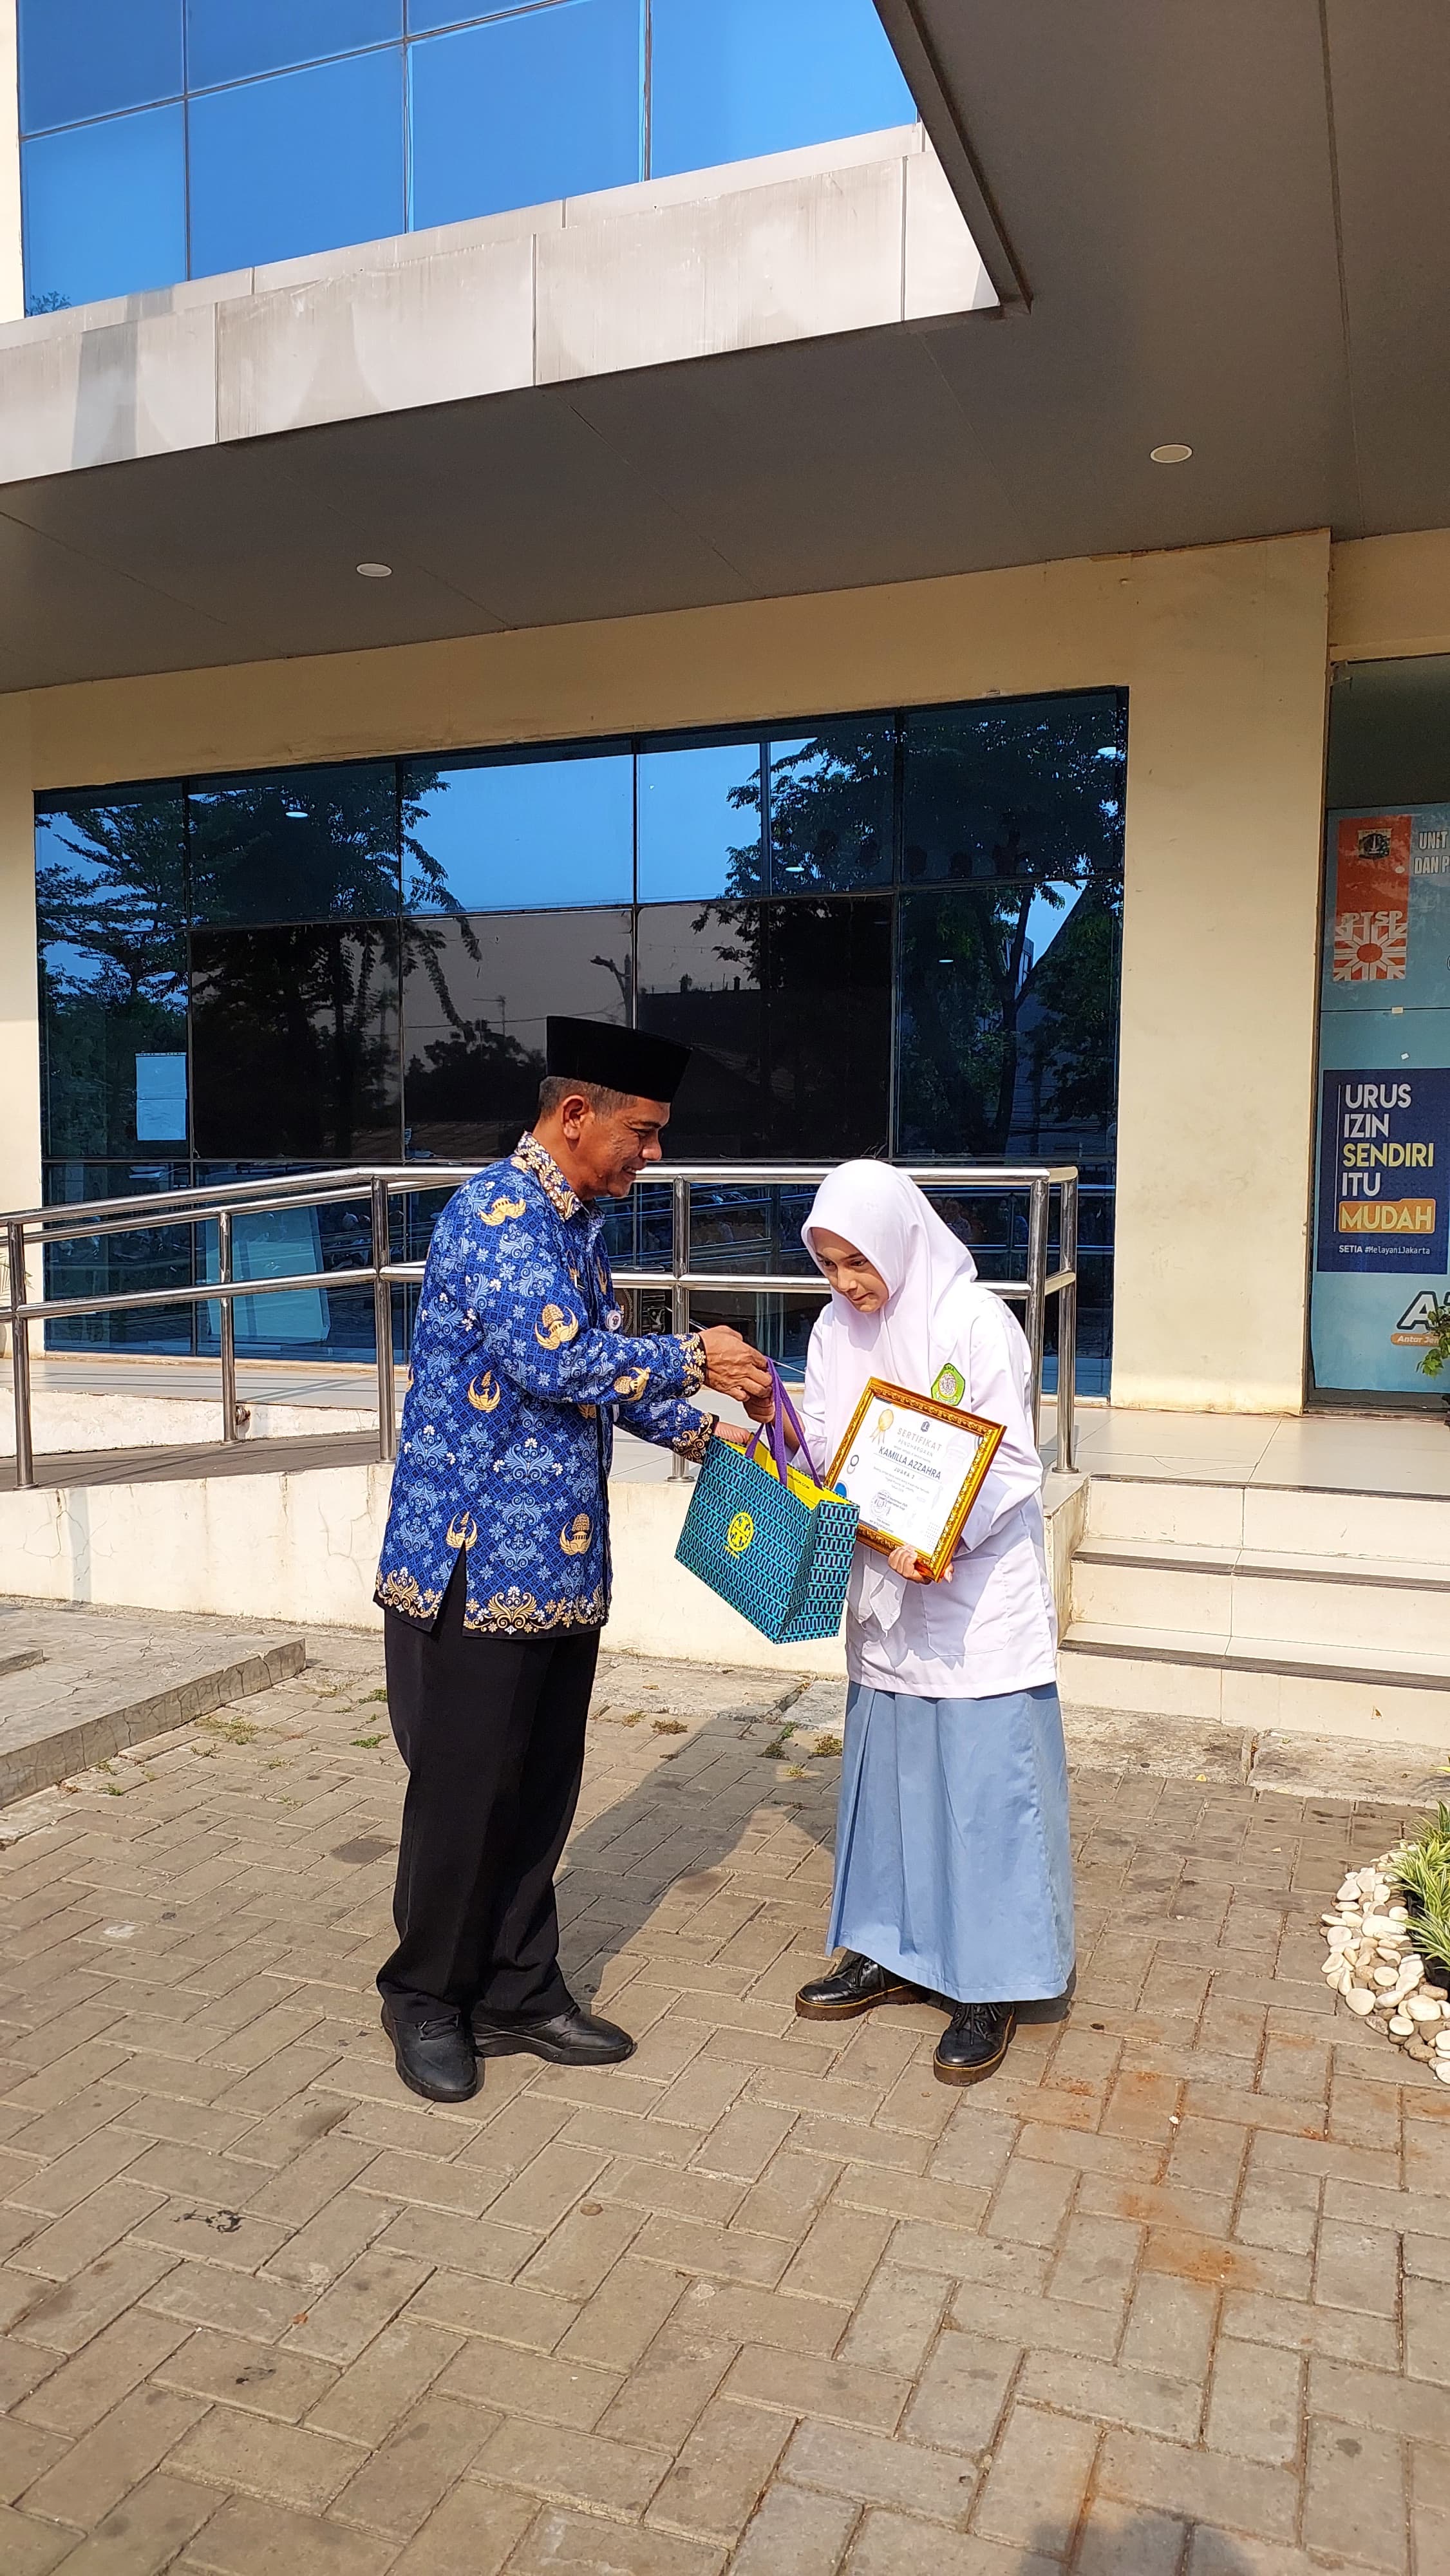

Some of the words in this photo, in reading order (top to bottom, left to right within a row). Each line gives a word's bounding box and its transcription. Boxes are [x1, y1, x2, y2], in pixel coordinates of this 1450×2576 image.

[1418, 831, 1448, 849] UNIT
[1414, 857, 1439, 875] DAN
[1341, 910, 1404, 933] PTSP
[1345, 1083, 1411, 1108] URUS
[1344, 1113, 1389, 1138] IZIN
[1342, 1142, 1434, 1167] SENDIRI
[1342, 1172, 1380, 1197] ITU
[1341, 1205, 1432, 1230] MUDAH
[898, 1428, 942, 1451] SERTIFIKAT
[879, 1446, 907, 1464] KAMILLA
[908, 1459, 941, 1479] AZZAHRA
[894, 1467, 910, 1477] JUARA
